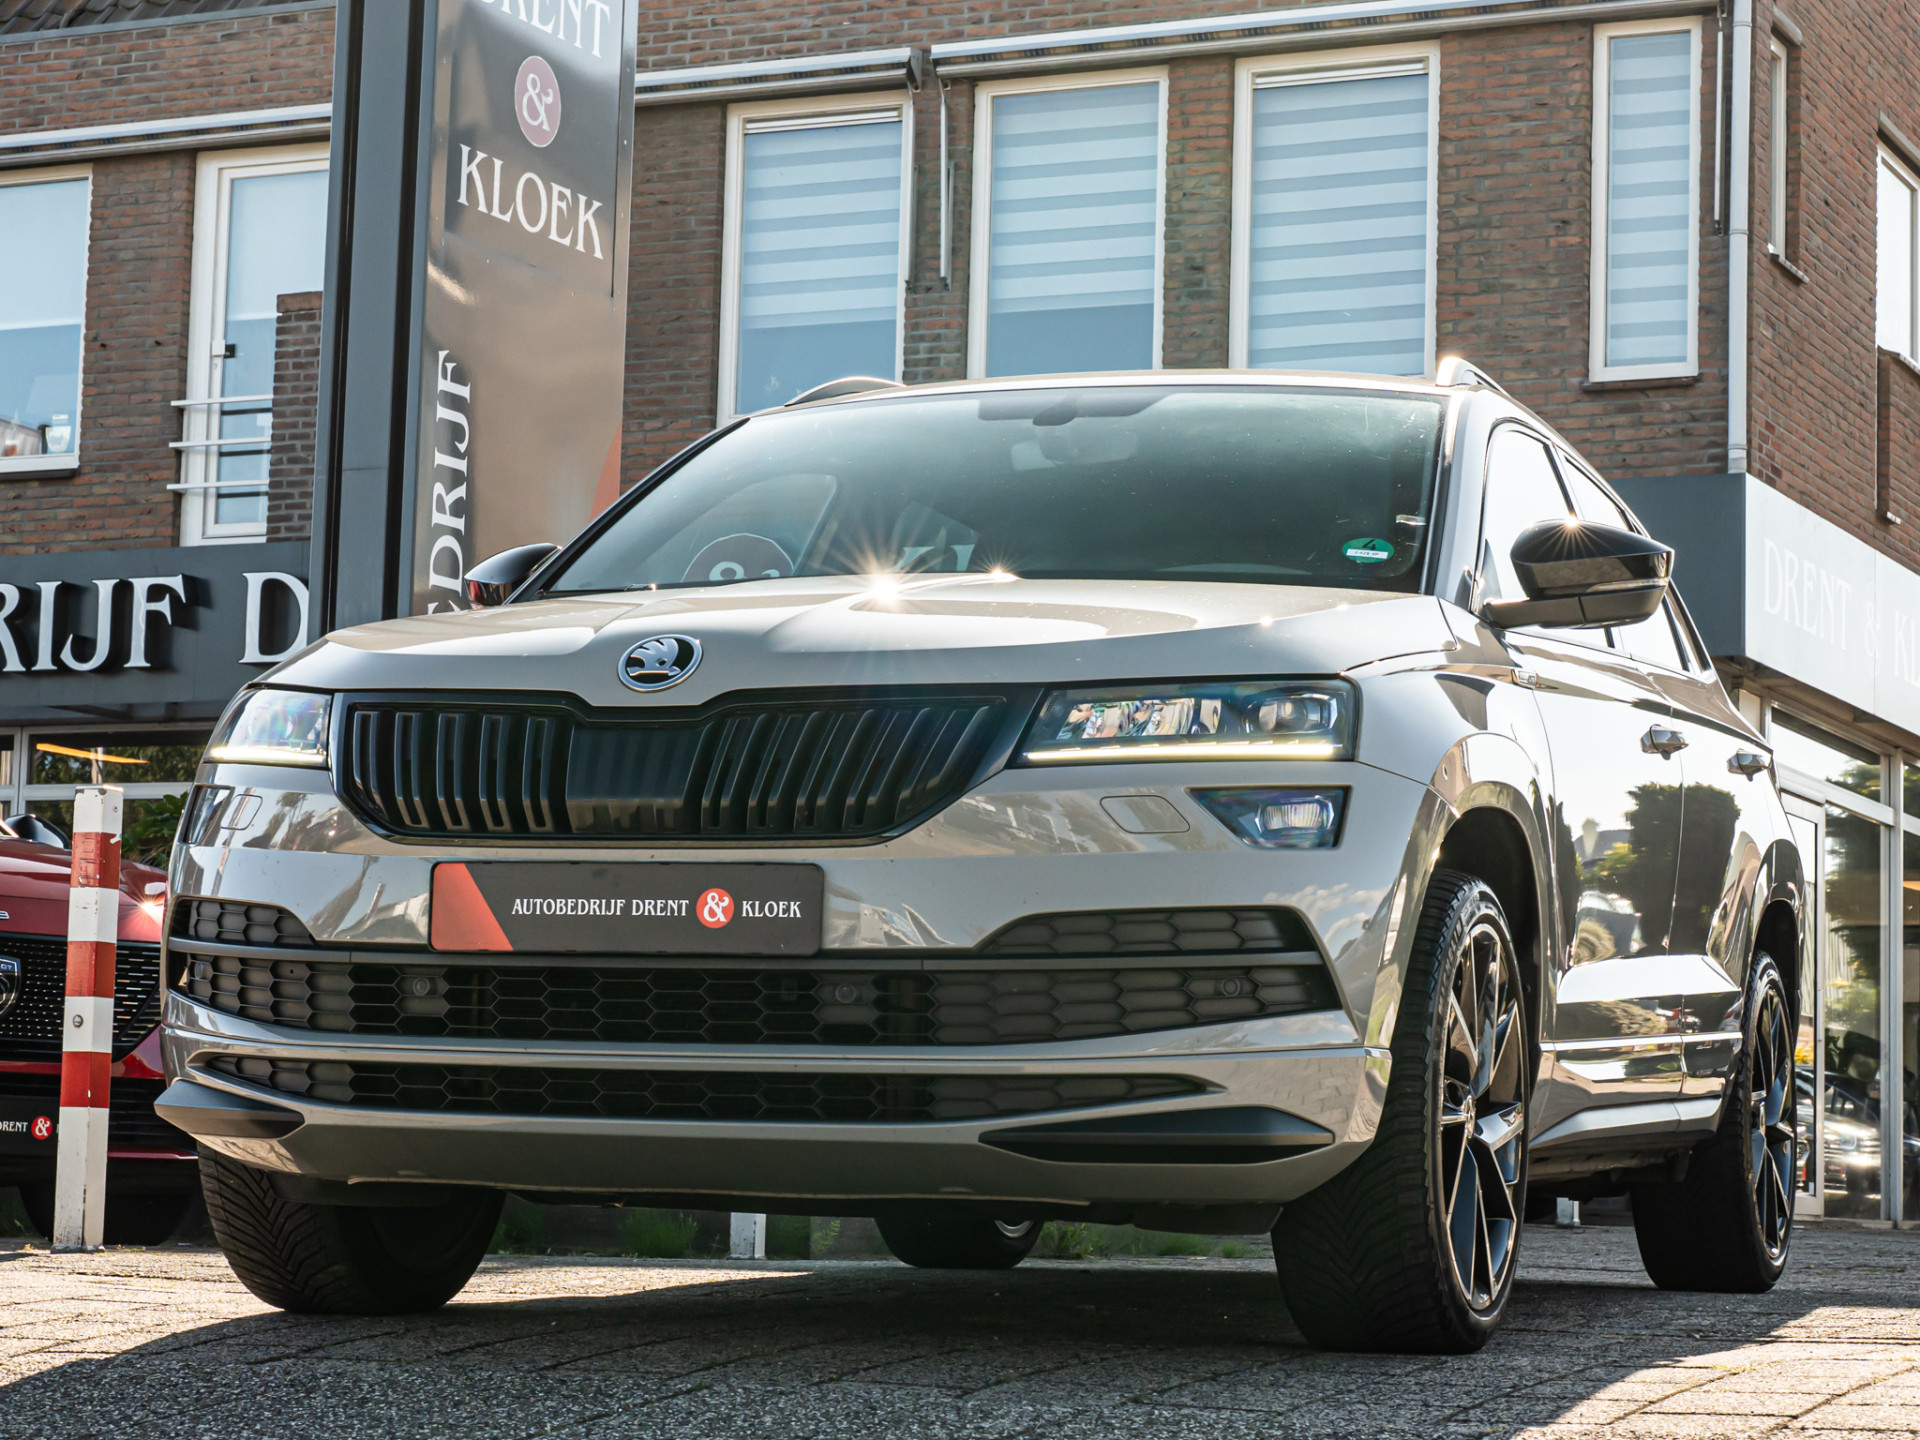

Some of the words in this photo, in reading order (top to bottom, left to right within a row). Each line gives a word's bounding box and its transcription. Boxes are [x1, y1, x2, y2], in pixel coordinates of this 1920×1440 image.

[522, 73, 554, 132] &
[457, 143, 604, 260] KLOEK
[428, 350, 471, 614] DRIJF
[1763, 537, 1852, 650] DRENT
[512, 898, 626, 916] AUTOBEDRIJF
[631, 899, 689, 917] DRENT
[703, 892, 730, 922] &
[742, 901, 801, 918] KLOEK
[35, 1118, 50, 1136] &
